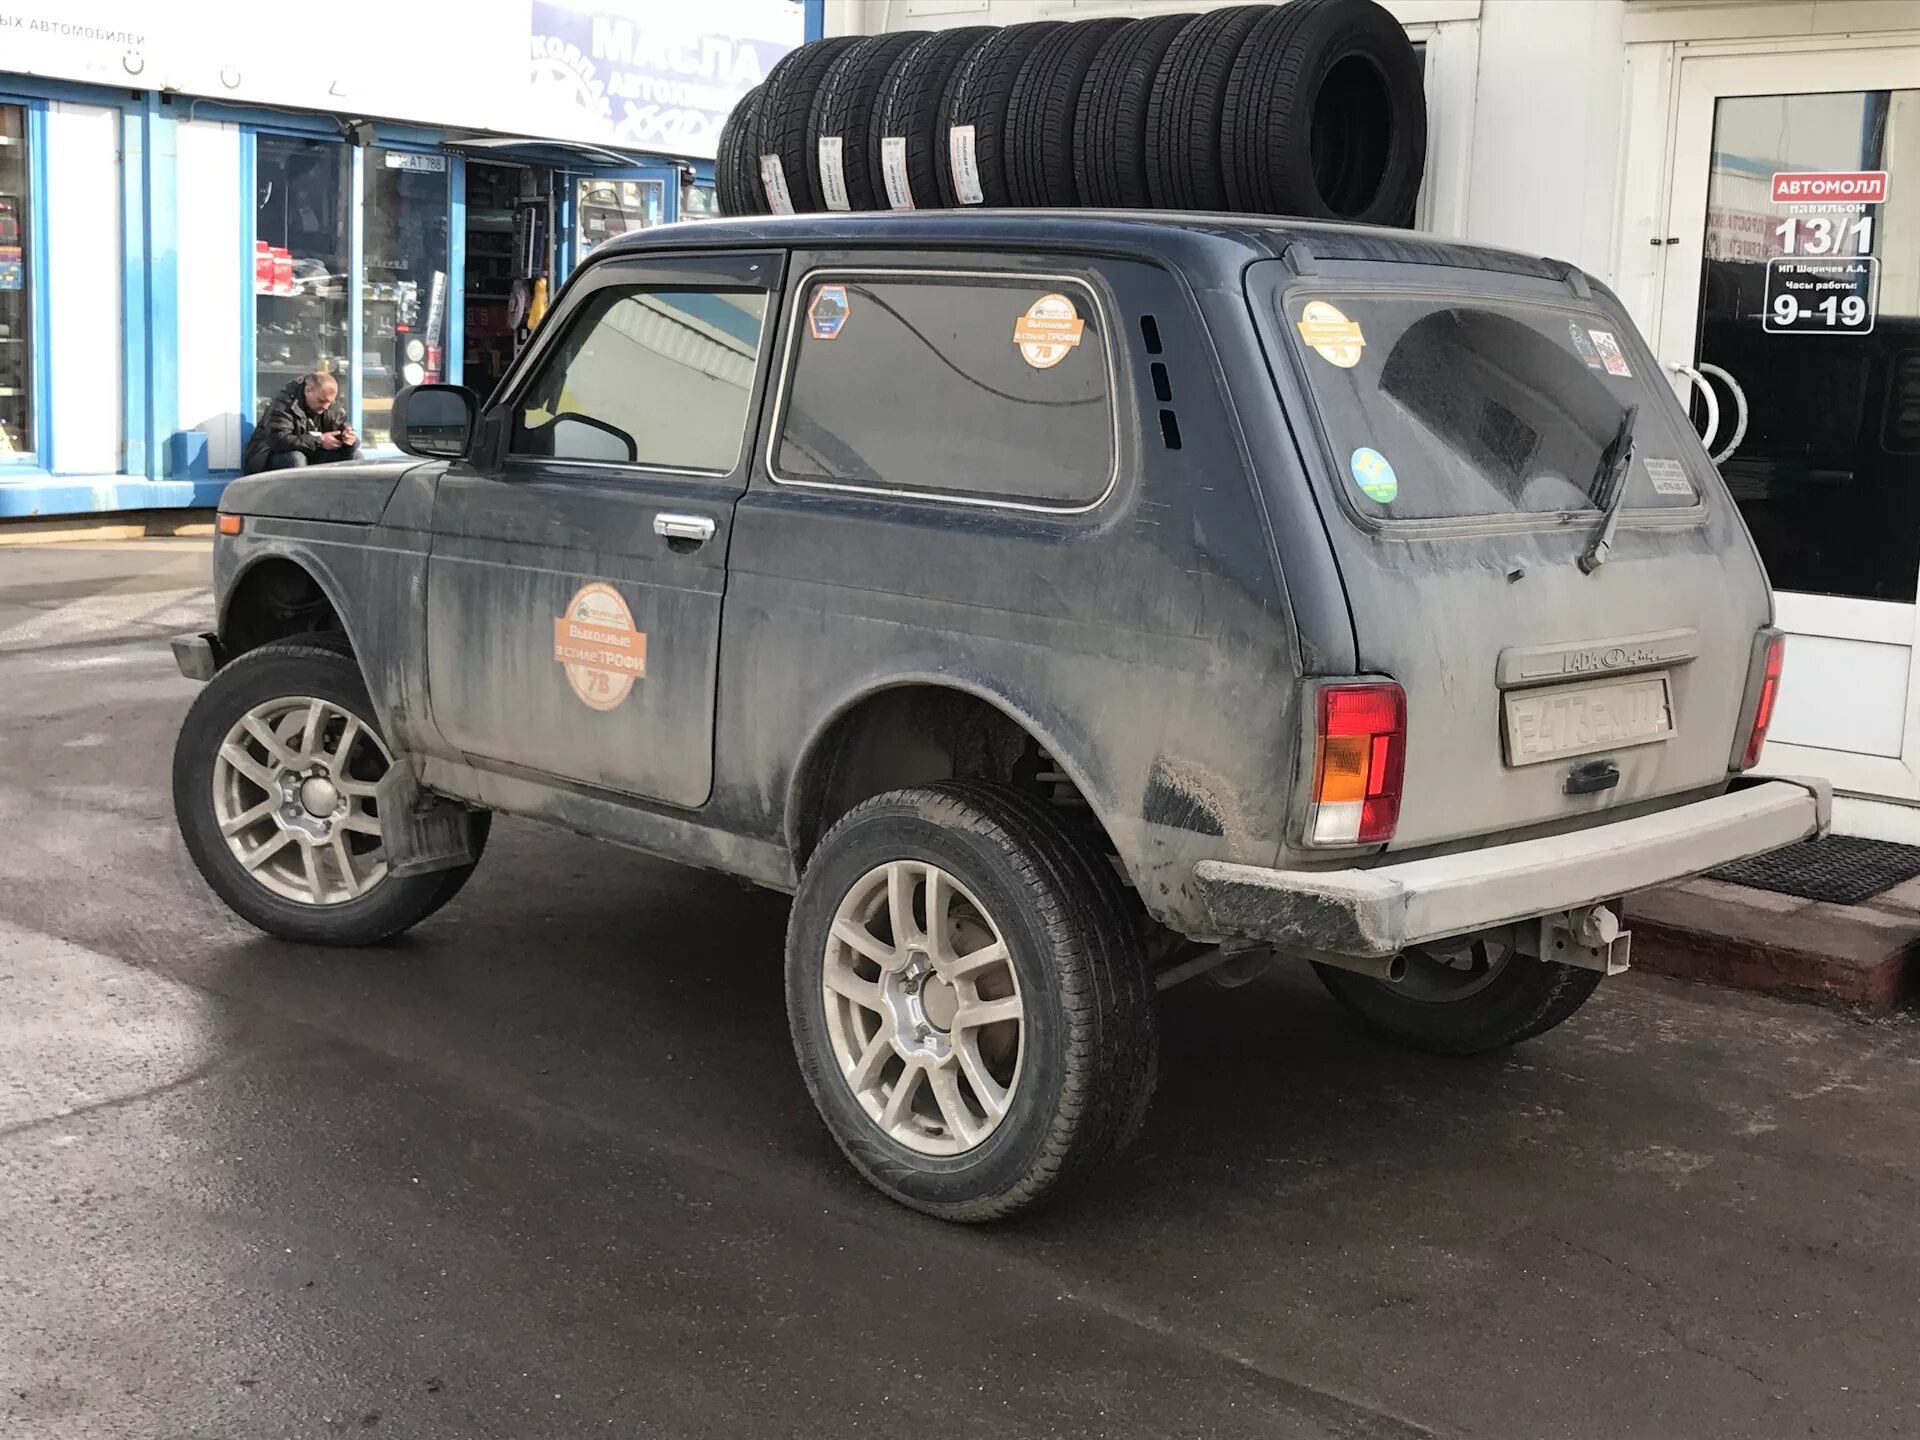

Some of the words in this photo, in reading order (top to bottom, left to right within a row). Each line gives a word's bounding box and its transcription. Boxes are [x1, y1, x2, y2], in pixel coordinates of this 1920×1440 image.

[1777, 179, 1881, 194] АВТОМОЛЛ
[1790, 204, 1866, 213] павильон
[1775, 216, 1872, 254] 13/1
[1778, 265, 1794, 273] ИП
[1846, 264, 1867, 273] А.А.
[1785, 280, 1813, 289] Часы
[1816, 280, 1857, 291] работы:
[569, 624, 630, 648] Выходные
[599, 651, 644, 671] ТРОФИ
[1563, 652, 1598, 674] LADA
[587, 670, 609, 694] 78
